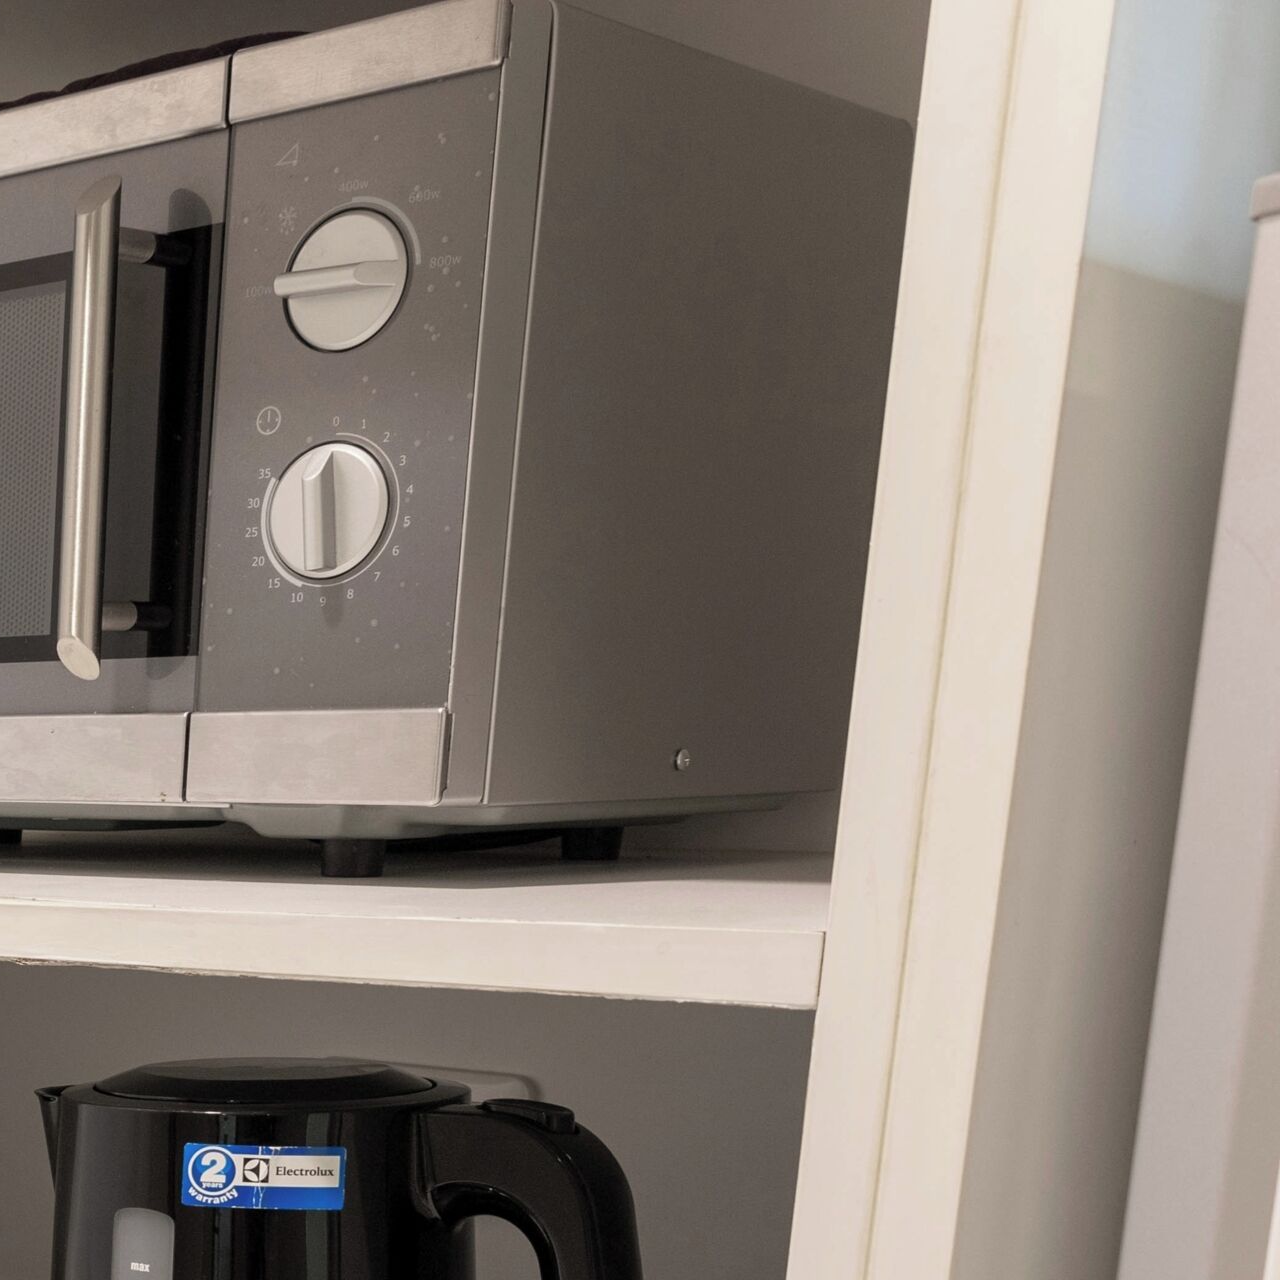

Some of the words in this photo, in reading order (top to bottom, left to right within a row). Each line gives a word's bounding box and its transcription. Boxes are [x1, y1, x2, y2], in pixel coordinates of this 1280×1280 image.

[333, 416, 340, 427] 0
[361, 419, 367, 429] 1
[383, 432, 391, 443] 2
[399, 455, 407, 466] 3
[258, 468, 271, 479] 35
[406, 484, 414, 495] 4
[247, 498, 260, 509] 30
[403, 516, 411, 527] 5
[245, 527, 258, 538] 25
[392, 545, 400, 556] 6
[251, 556, 265, 567] 20
[374, 572, 381, 583] 7
[267, 578, 281, 589] 15
[290, 592, 304, 603] 10
[347, 588, 354, 600] 8
[319, 596, 326, 607] 9
[199, 1151, 227, 1183] 2
[275, 1166, 334, 1177] Electrolux
[202, 1181, 224, 1189] years
[187, 1186, 239, 1204] warranty
[130, 1261, 150, 1273] max
